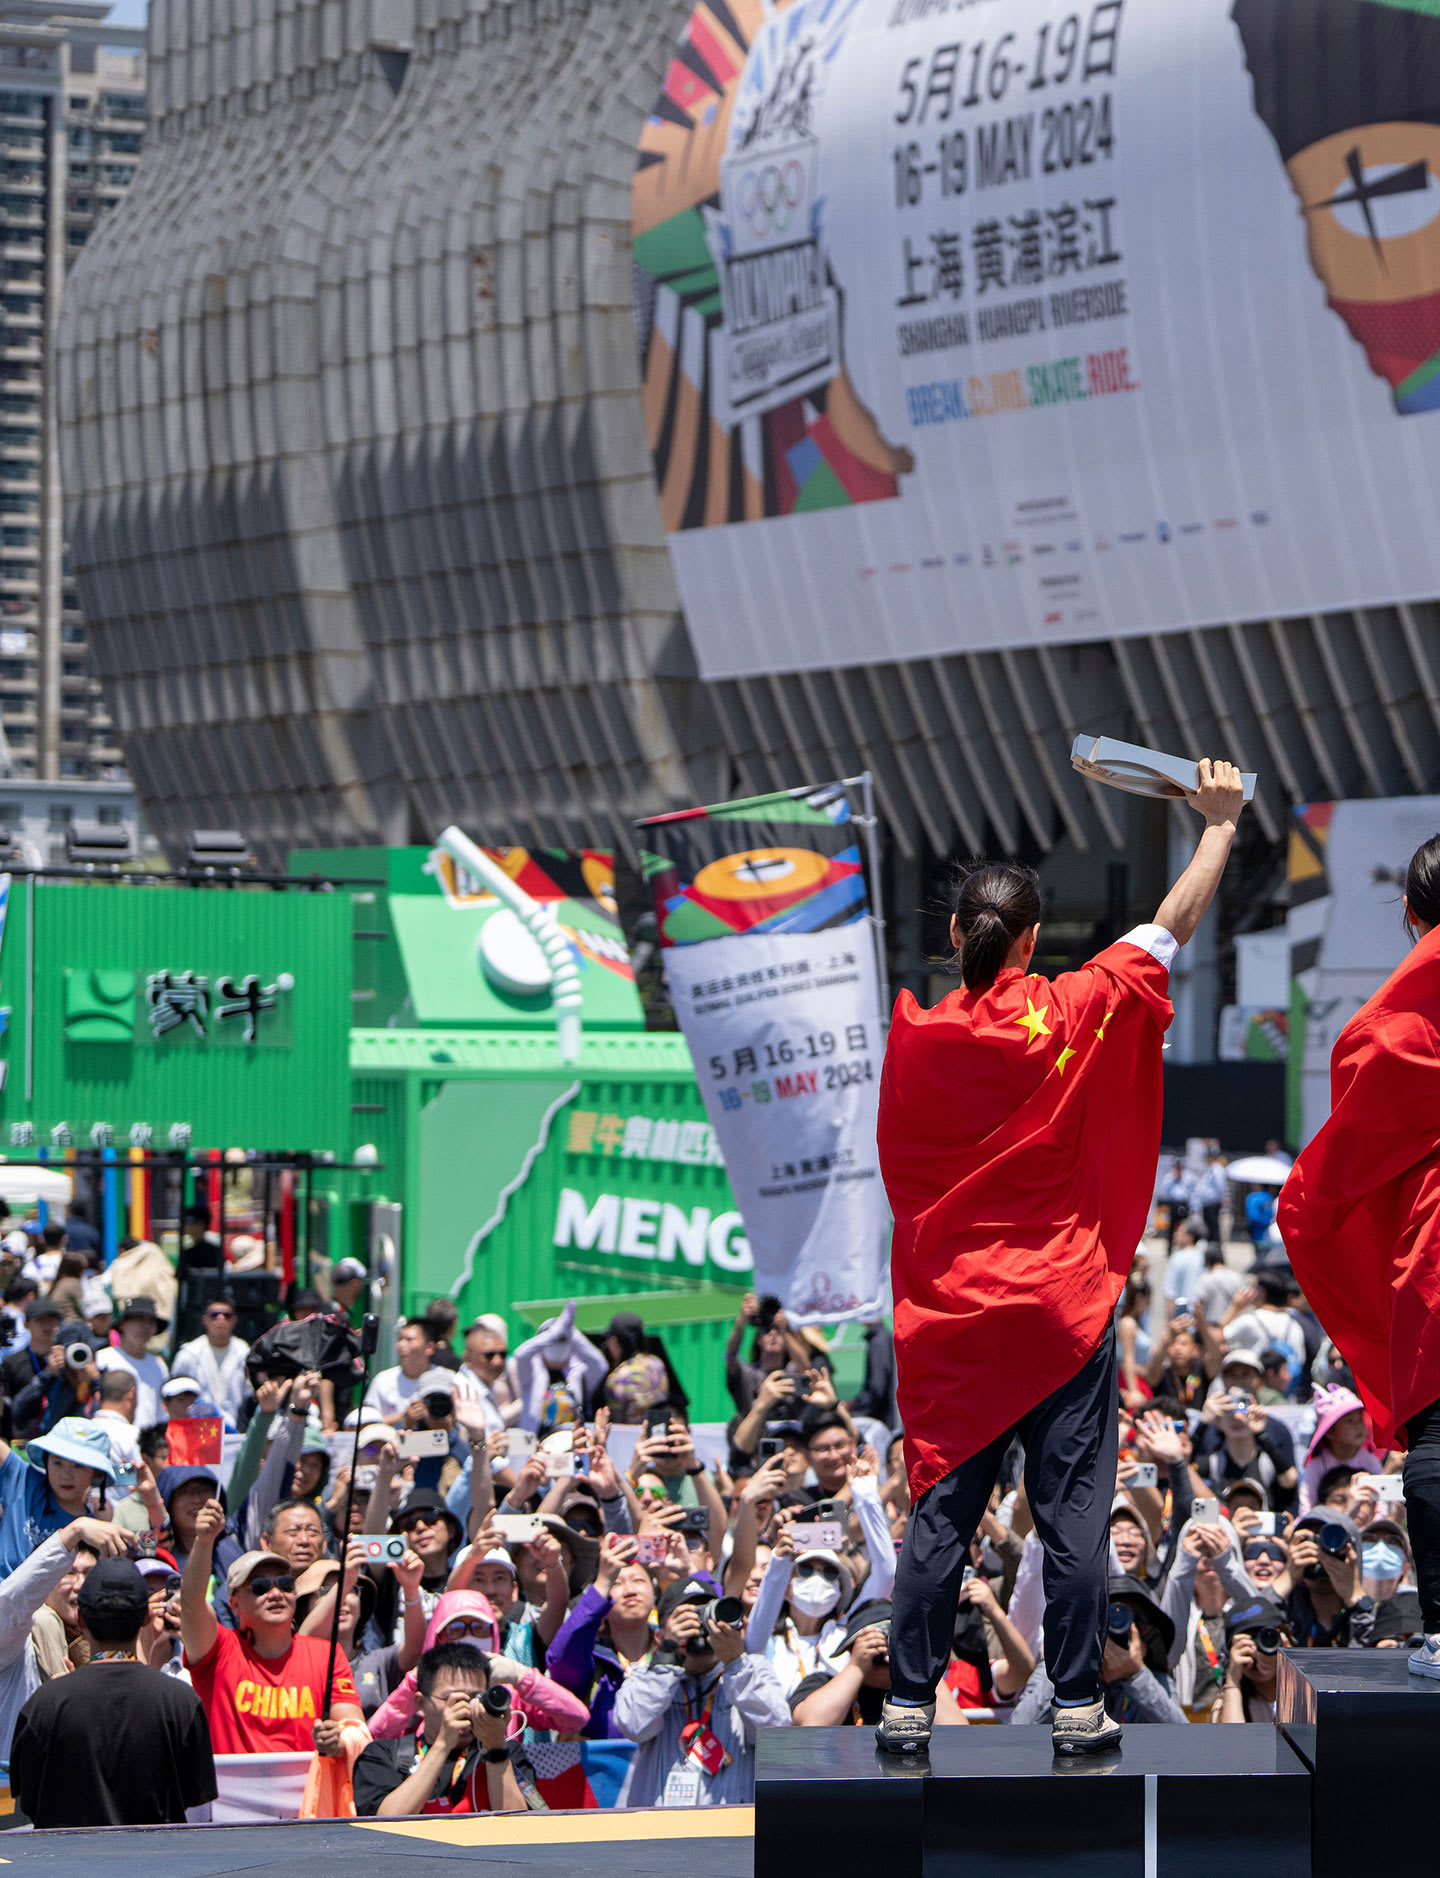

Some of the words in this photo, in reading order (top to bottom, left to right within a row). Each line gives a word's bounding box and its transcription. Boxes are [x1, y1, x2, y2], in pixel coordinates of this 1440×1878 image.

[893, 129, 969, 208] 16-19
[974, 110, 1034, 190] MAY
[1040, 92, 1114, 175] 2024
[897, 232, 964, 308] 上海
[146, 968, 294, 1043] 蒙牛
[775, 1069, 818, 1100] MAY
[235, 1679, 316, 1719] CHINA
